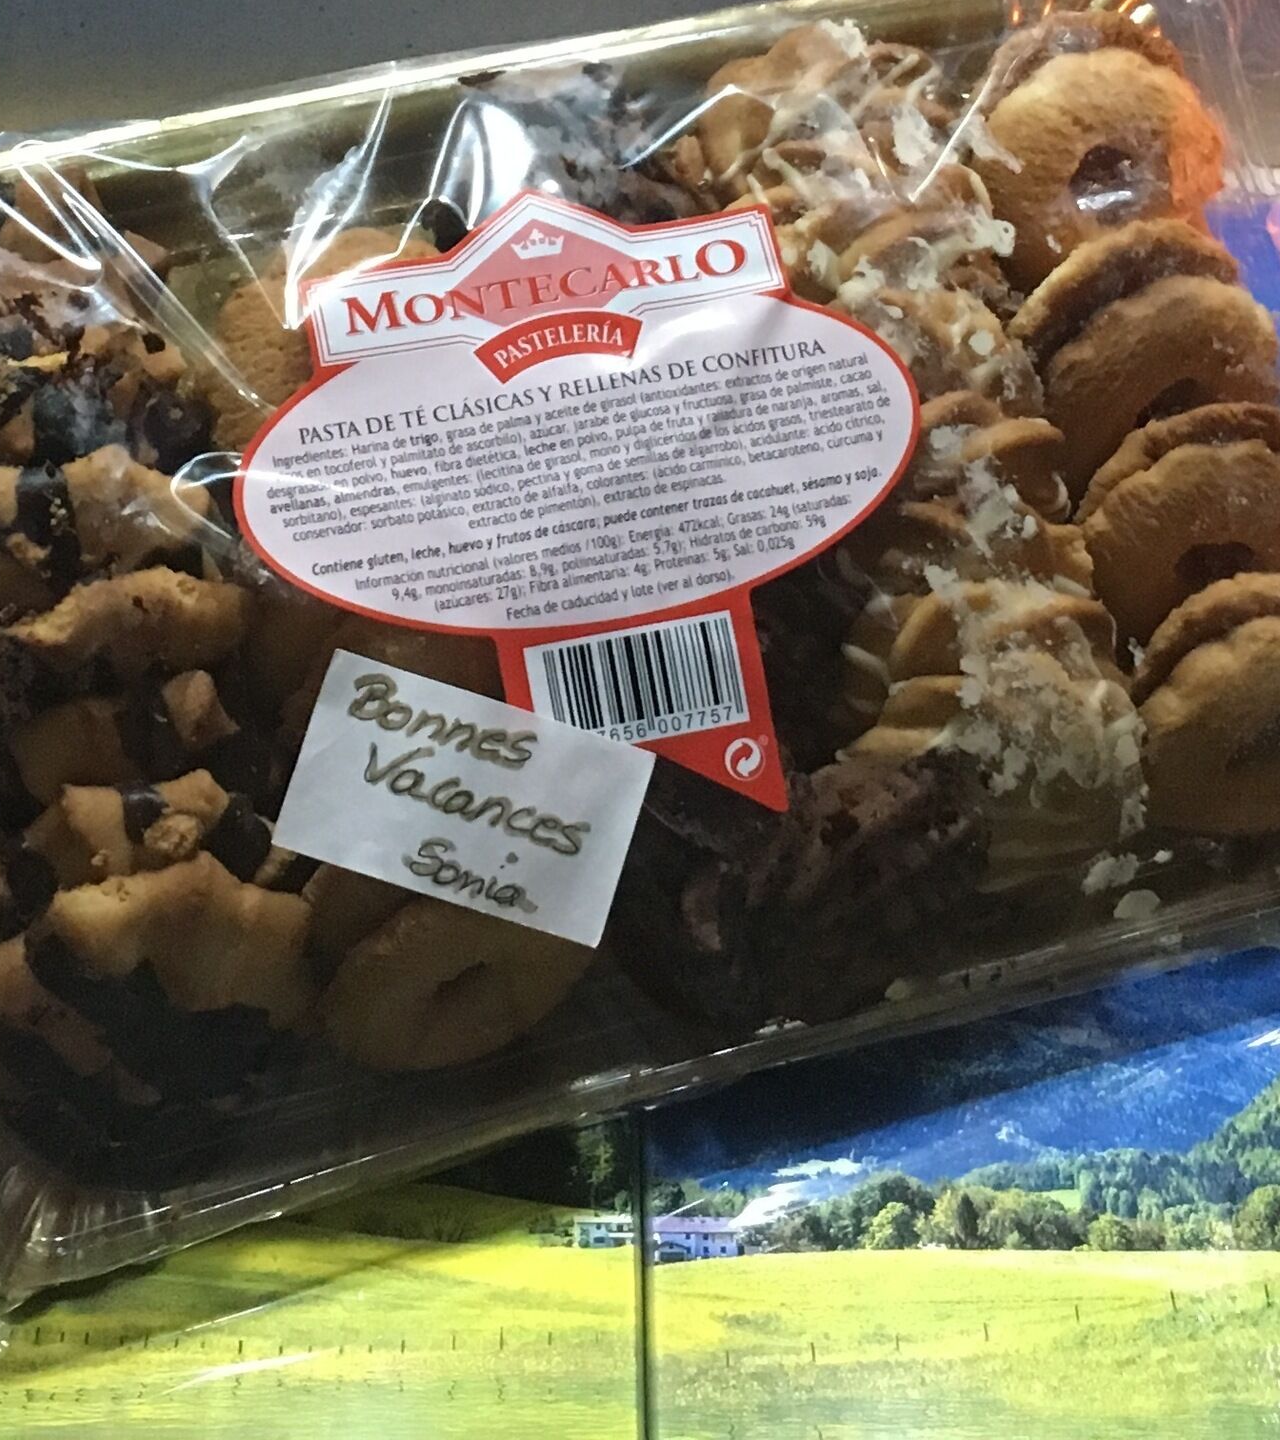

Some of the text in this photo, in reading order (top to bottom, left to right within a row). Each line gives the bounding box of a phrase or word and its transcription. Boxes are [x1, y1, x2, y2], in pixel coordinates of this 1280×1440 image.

[343, 238, 747, 336] MONTECARLO
[494, 321, 625, 370] PASTELERÍA
[273, 444, 347, 469] Ingredientes:
[352, 440, 388, 456] Harina
[392, 436, 407, 449] de
[410, 431, 442, 448] trigo,
[446, 426, 475, 442] grasa
[478, 420, 494, 434] de
[497, 414, 531, 432] palma
[545, 406, 579, 421] aceite
[582, 400, 597, 413] de
[600, 394, 636, 412] girasol
[774, 368, 789, 381] de
[792, 363, 826, 380] origen
[828, 353, 867, 371] natural
[300, 337, 824, 444] PASTA DE TÉ CLÁSICAS Y RELLENAS DE CONFITURA
[324, 456, 375, 474] tocoferol
[390, 445, 444, 464] palmitato
[448, 442, 463, 455] de
[574, 415, 608, 432] jarabe
[611, 410, 627, 423] de
[630, 403, 670, 421] glucosa
[740, 389, 766, 405] grasa
[768, 384, 783, 397] de
[840, 370, 871, 384] cacao
[270, 494, 329, 514] avellanas,
[526, 458, 541, 471] de
[875, 394, 891, 408] de
[391, 462, 430, 480] huevo,
[435, 458, 461, 473] fibra
[524, 440, 556, 456] leche
[615, 424, 646, 440] pulpa
[648, 419, 663, 432] de
[666, 414, 693, 429] fruta
[754, 402, 769, 415] de
[606, 457, 621, 470] de
[671, 445, 686, 459] de
[312, 556, 362, 576] Contiene
[367, 549, 407, 569] gluten,
[411, 543, 444, 562] leche,
[448, 537, 482, 554] huevo
[497, 528, 531, 546] frutos
[533, 525, 549, 539] de
[603, 509, 637, 527] puede
[640, 501, 688, 519] contener
[693, 494, 727, 509] trazas
[729, 489, 745, 503] de
[854, 465, 881, 483] soja.
[468, 481, 667, 529] extracto de extracto de
[472, 495, 520, 513] extracto
[523, 490, 538, 503] de
[689, 530, 735, 548] Hidratos
[738, 526, 753, 539] de
[804, 512, 826, 530] 59g
[427, 558, 488, 579] nutricional
[541, 542, 580, 558] medios
[727, 507, 765, 525] Grasas:
[769, 503, 789, 520] 24g
[530, 577, 558, 593] Fibra
[757, 534, 794, 554] 0,025g
[505, 602, 540, 620] Fecha
[542, 599, 558, 613] de
[560, 588, 618, 610] caducidad
[621, 588, 628, 601] y
[630, 582, 654, 598] lote
[656, 578, 679, 595] (ver
[681, 575, 693, 588] al
[346, 672, 539, 771] Bonnes
[657, 706, 733, 734] 007757
[361, 741, 593, 859] Vacances
[401, 835, 539, 914] Sonia
